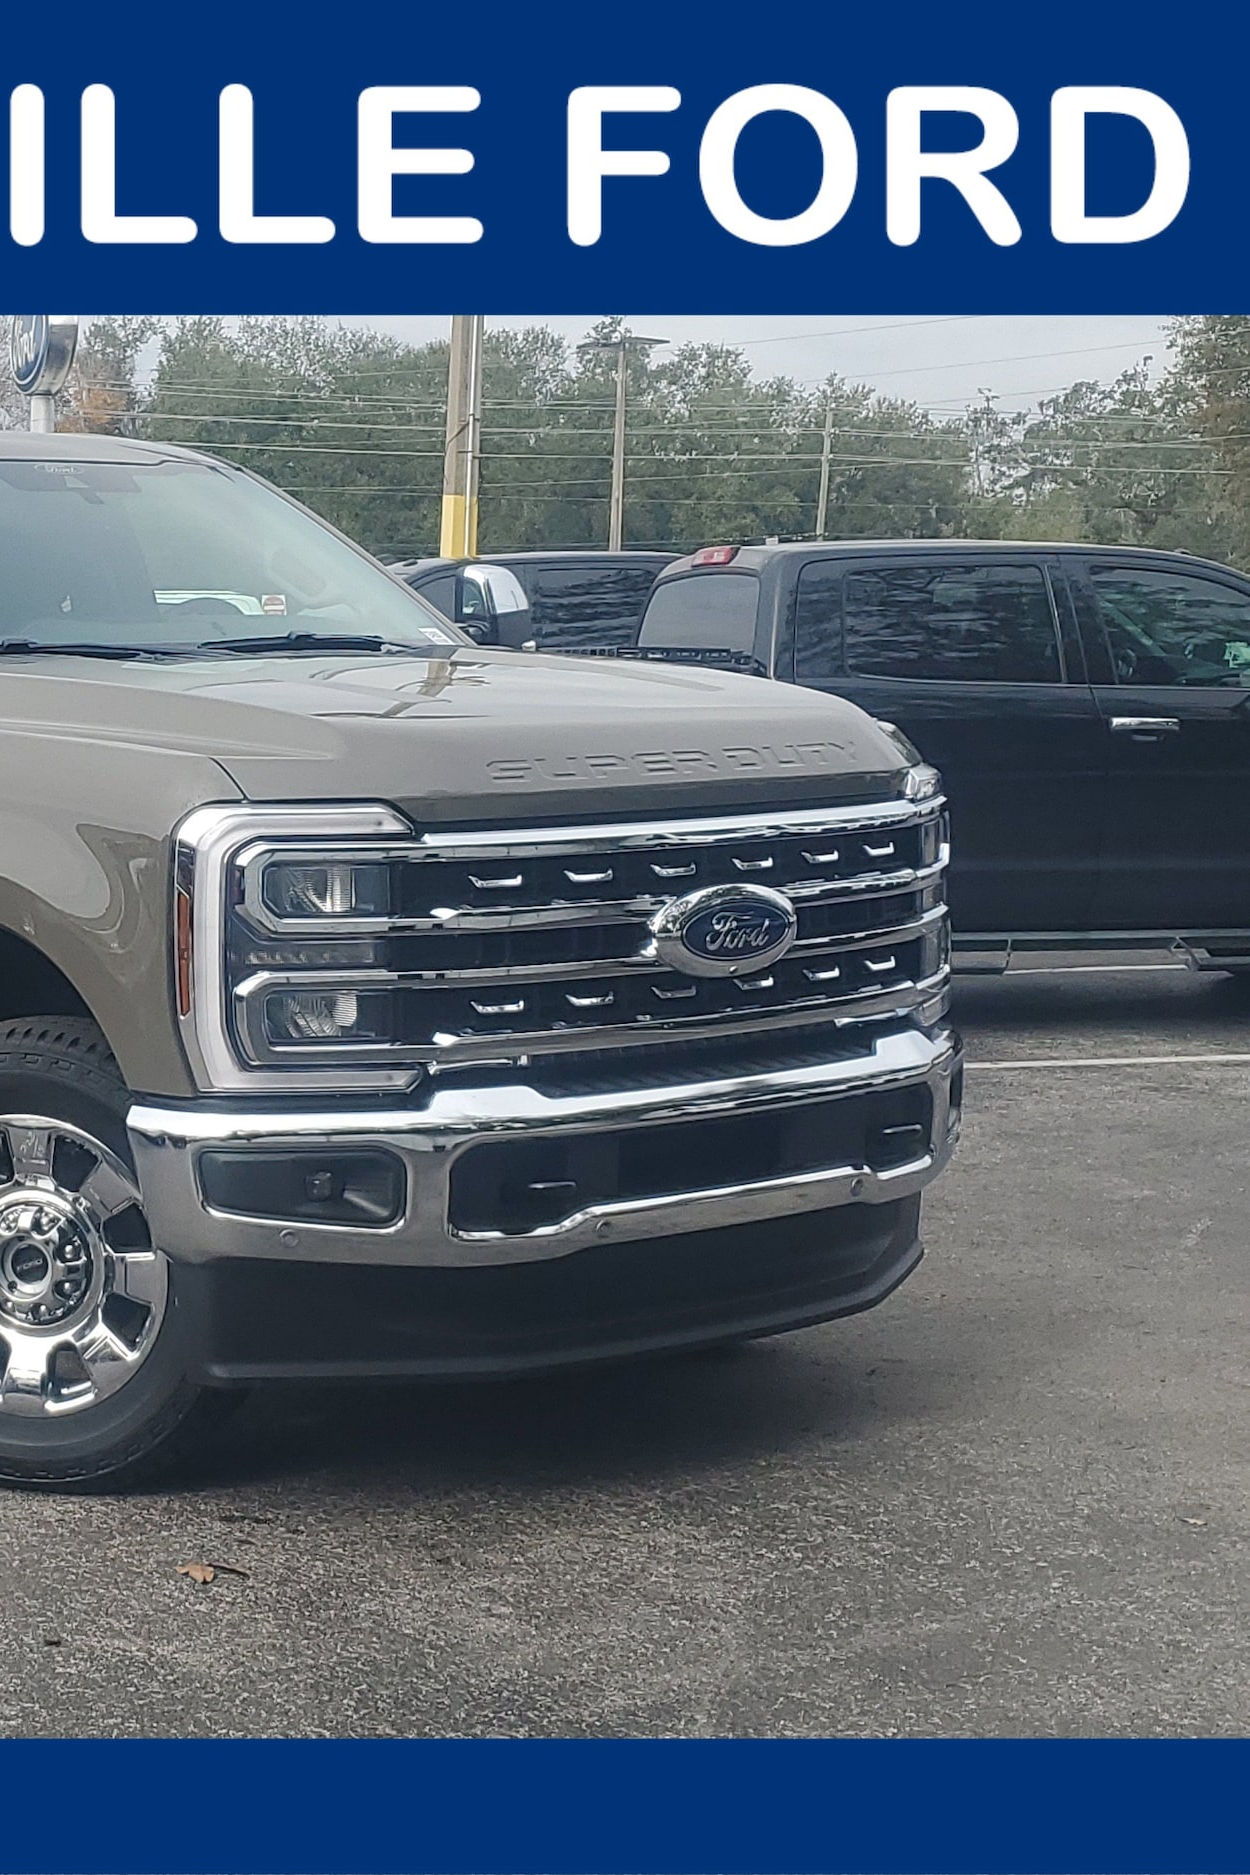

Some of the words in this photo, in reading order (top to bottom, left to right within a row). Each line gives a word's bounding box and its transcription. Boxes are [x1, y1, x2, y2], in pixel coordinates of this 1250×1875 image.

[485, 750, 718, 783] SUPER
[721, 741, 855, 771] DUTY
[705, 911, 771, 951] Ford
